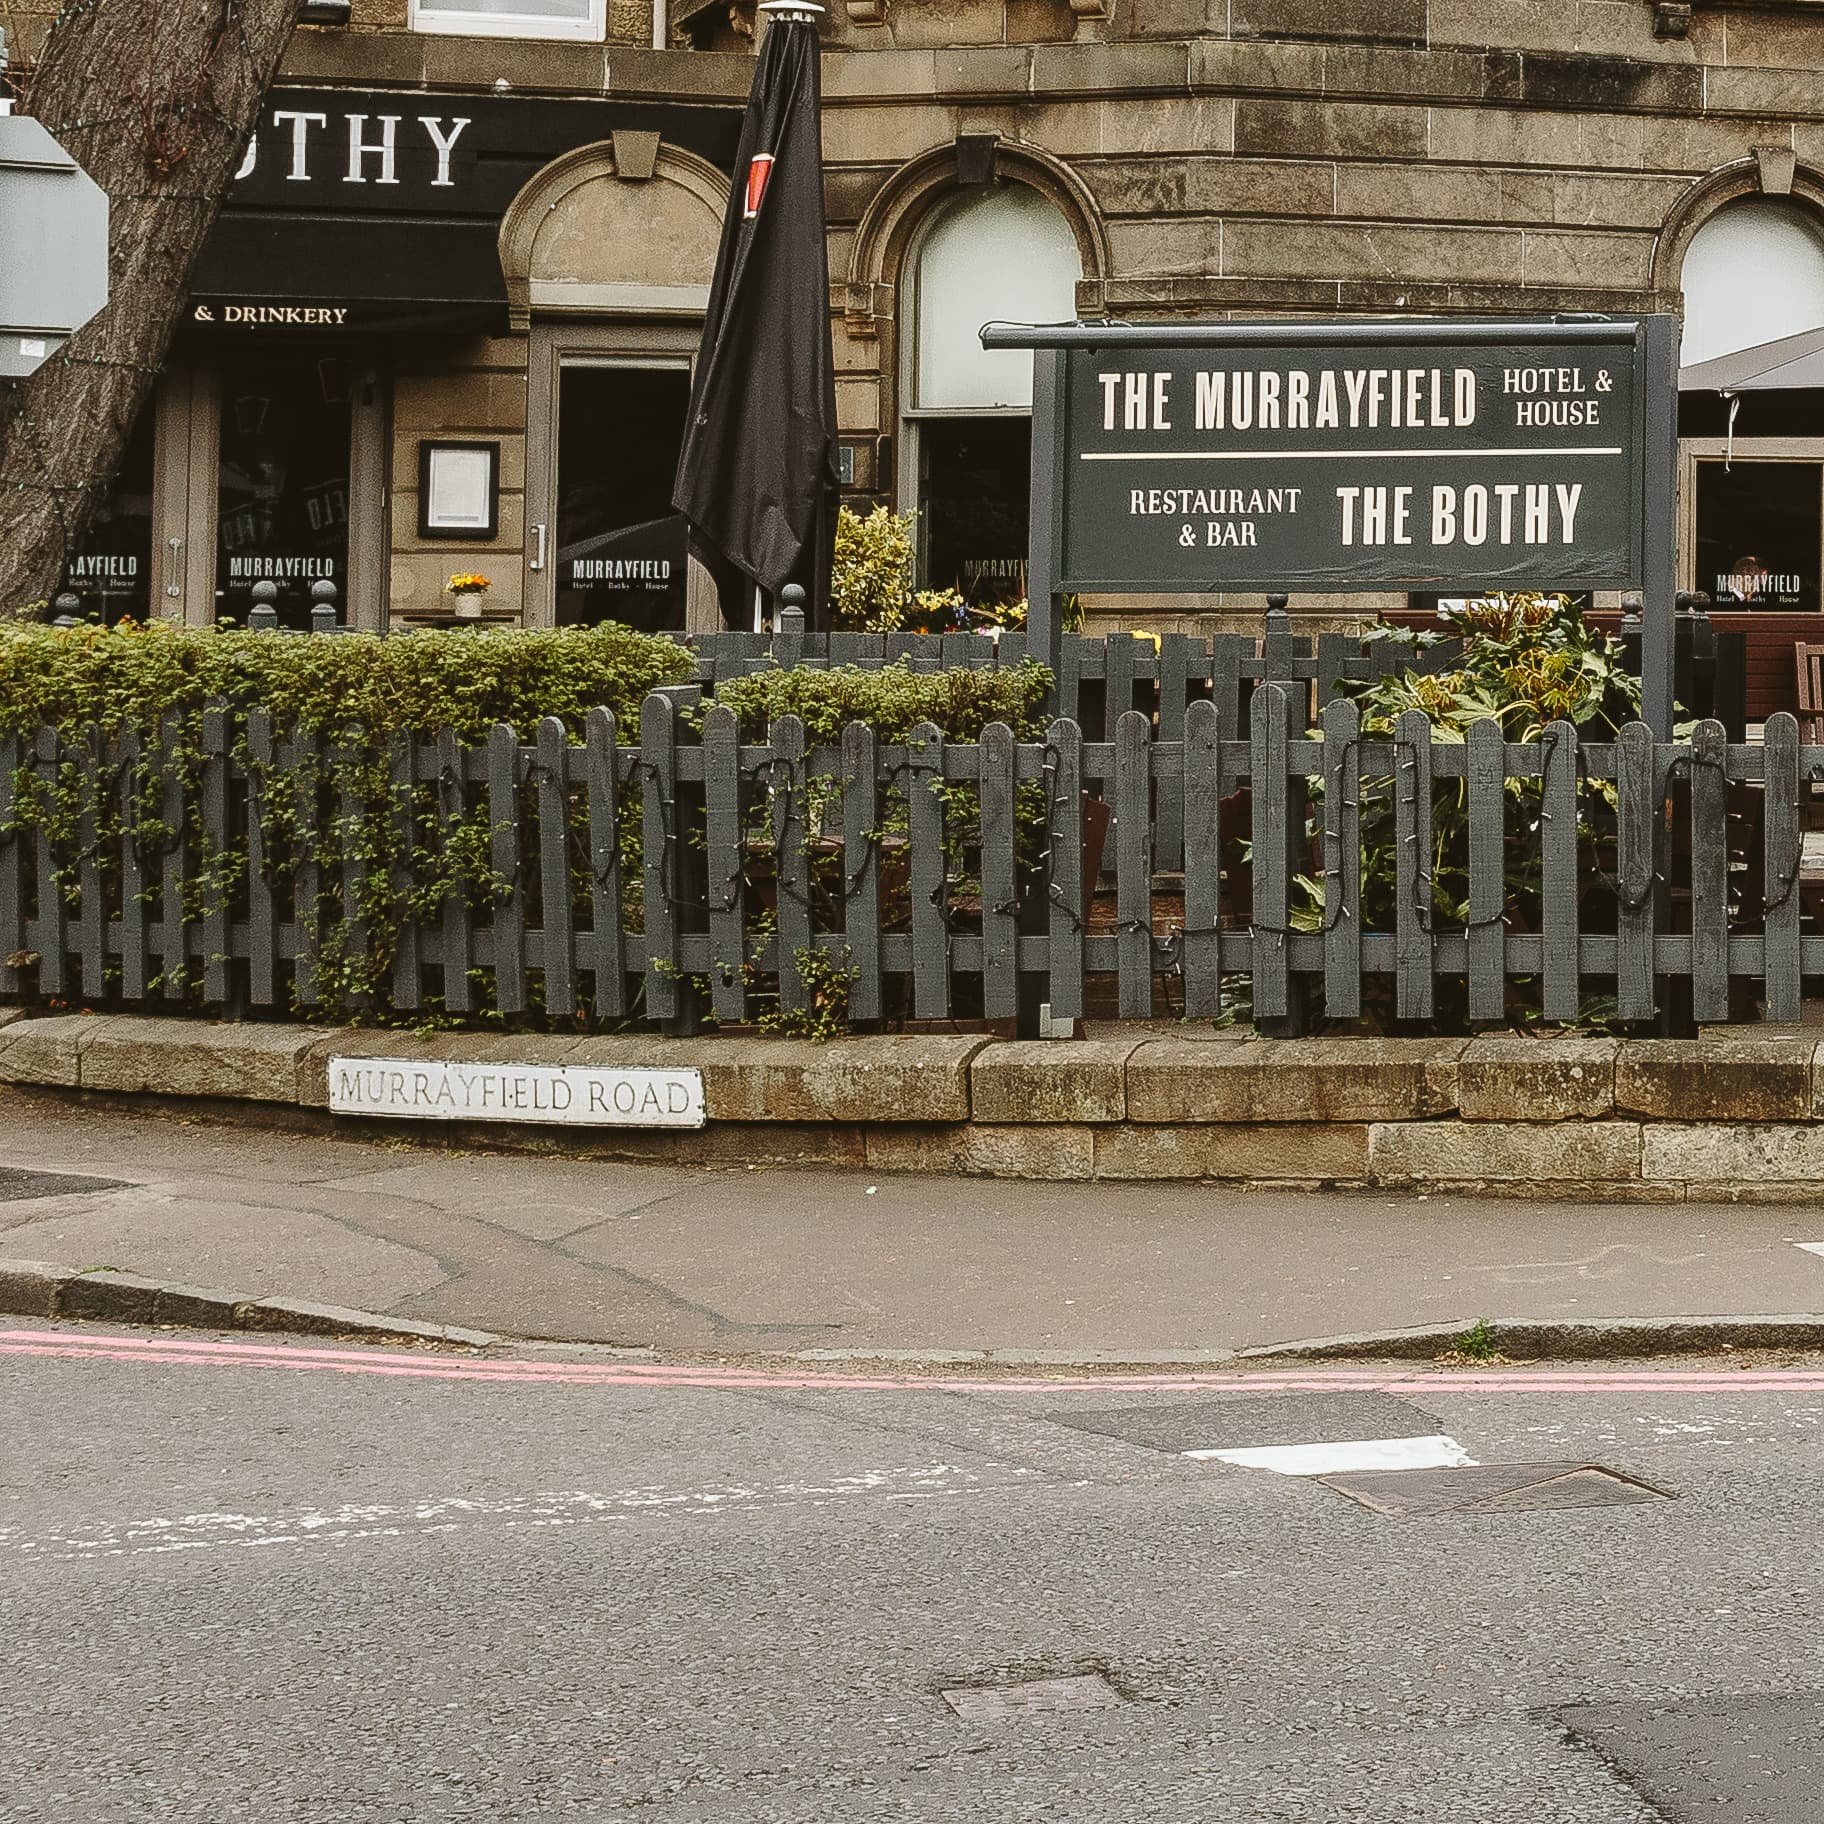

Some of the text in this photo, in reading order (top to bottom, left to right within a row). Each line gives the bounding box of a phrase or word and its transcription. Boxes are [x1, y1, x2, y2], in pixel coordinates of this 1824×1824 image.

[234, 110, 472, 186] THY
[194, 305, 348, 324] & DRINKERY
[1098, 368, 1613, 431] THE MURRAYFIELD HOTEL &
[1515, 398, 1600, 427] HOUSE
[1129, 483, 1584, 547] RESTAURANT THE BOTHY
[1178, 521, 1258, 548] & BAR
[229, 557, 334, 577] MURRAYFIELD
[573, 560, 671, 579] MURRAYFIELD
[1717, 574, 1800, 592] MURRAYFIELD
[339, 1069, 691, 1115] MURRAYFIELD ROAD
